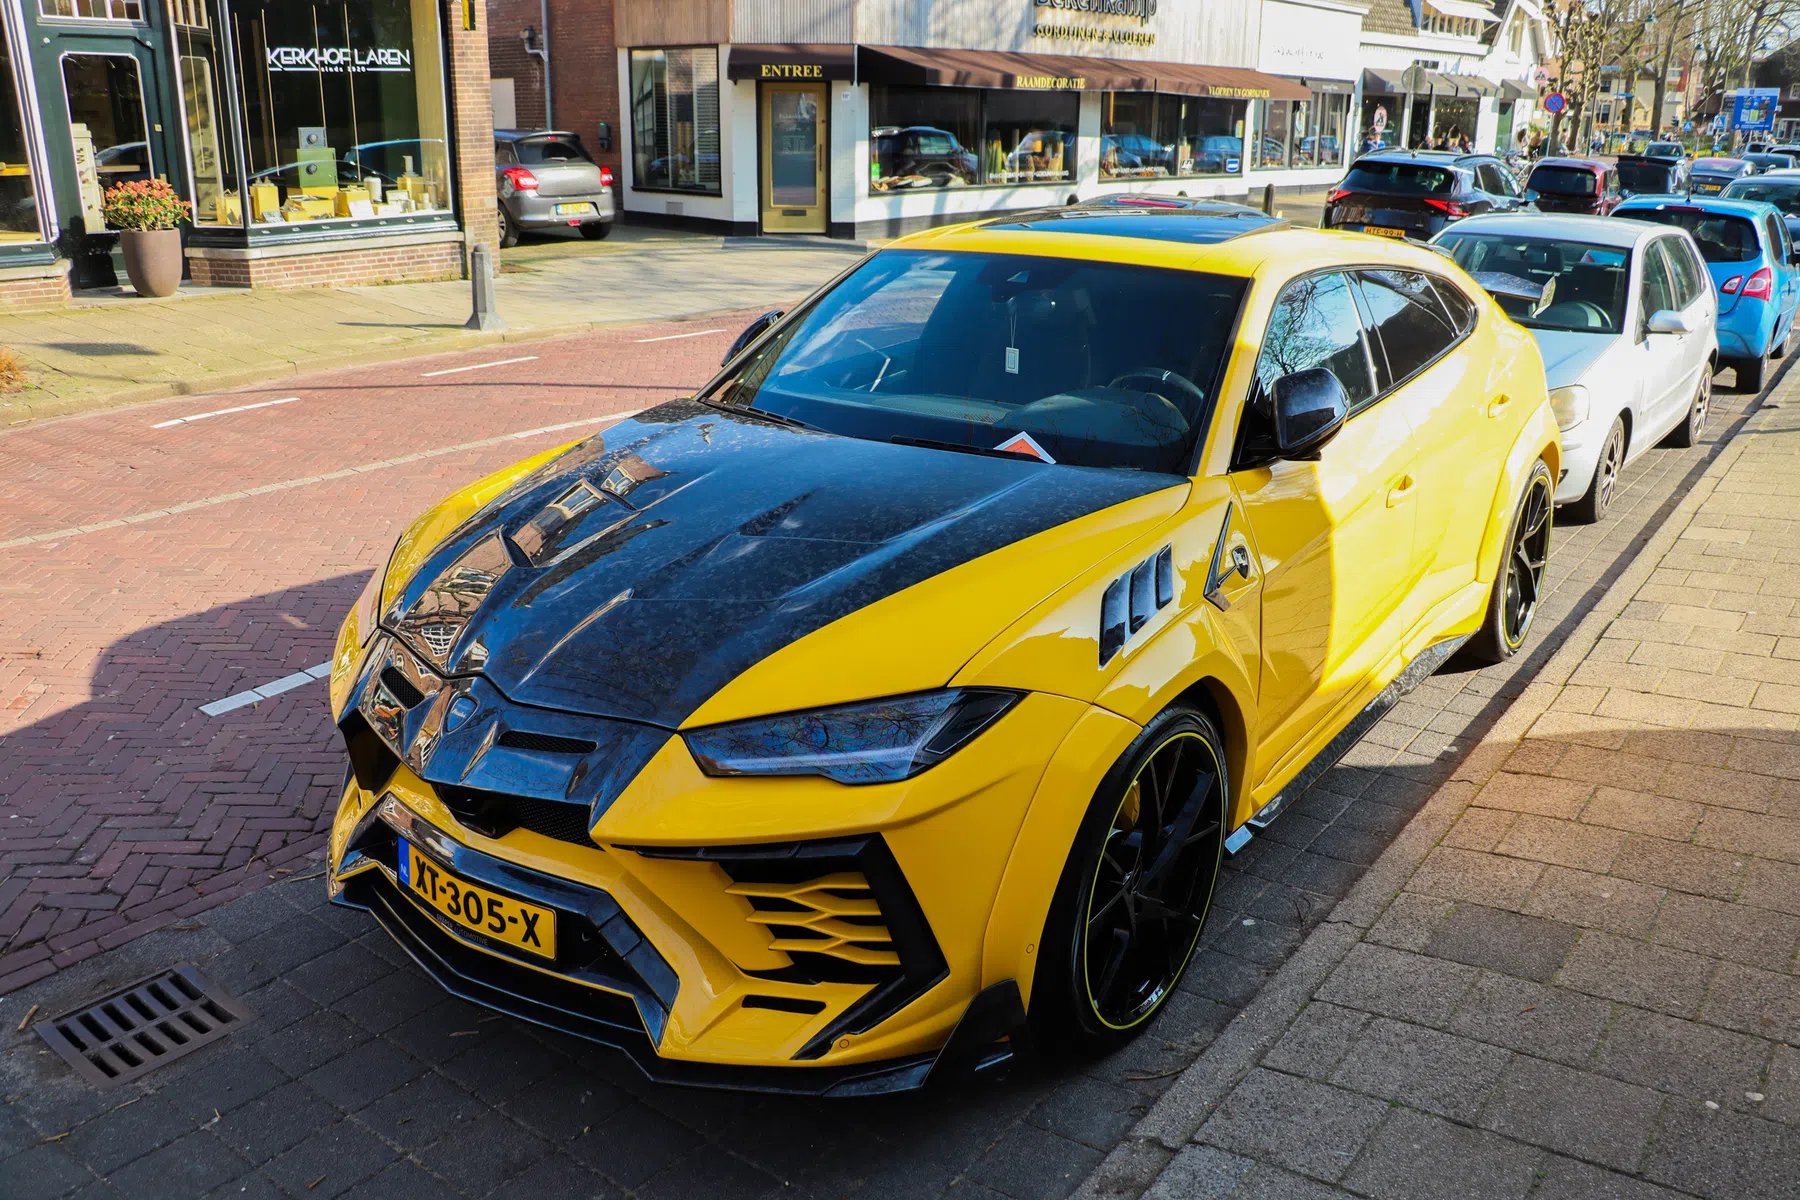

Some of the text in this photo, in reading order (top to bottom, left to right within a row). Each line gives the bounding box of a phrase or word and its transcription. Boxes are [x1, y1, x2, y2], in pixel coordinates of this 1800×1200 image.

[266, 47, 411, 69] KERKHOF LAREN
[761, 64, 823, 78] ENTREE
[1016, 75, 1086, 89] RAAMDECORATIE
[415, 855, 542, 948] XT-305-X
